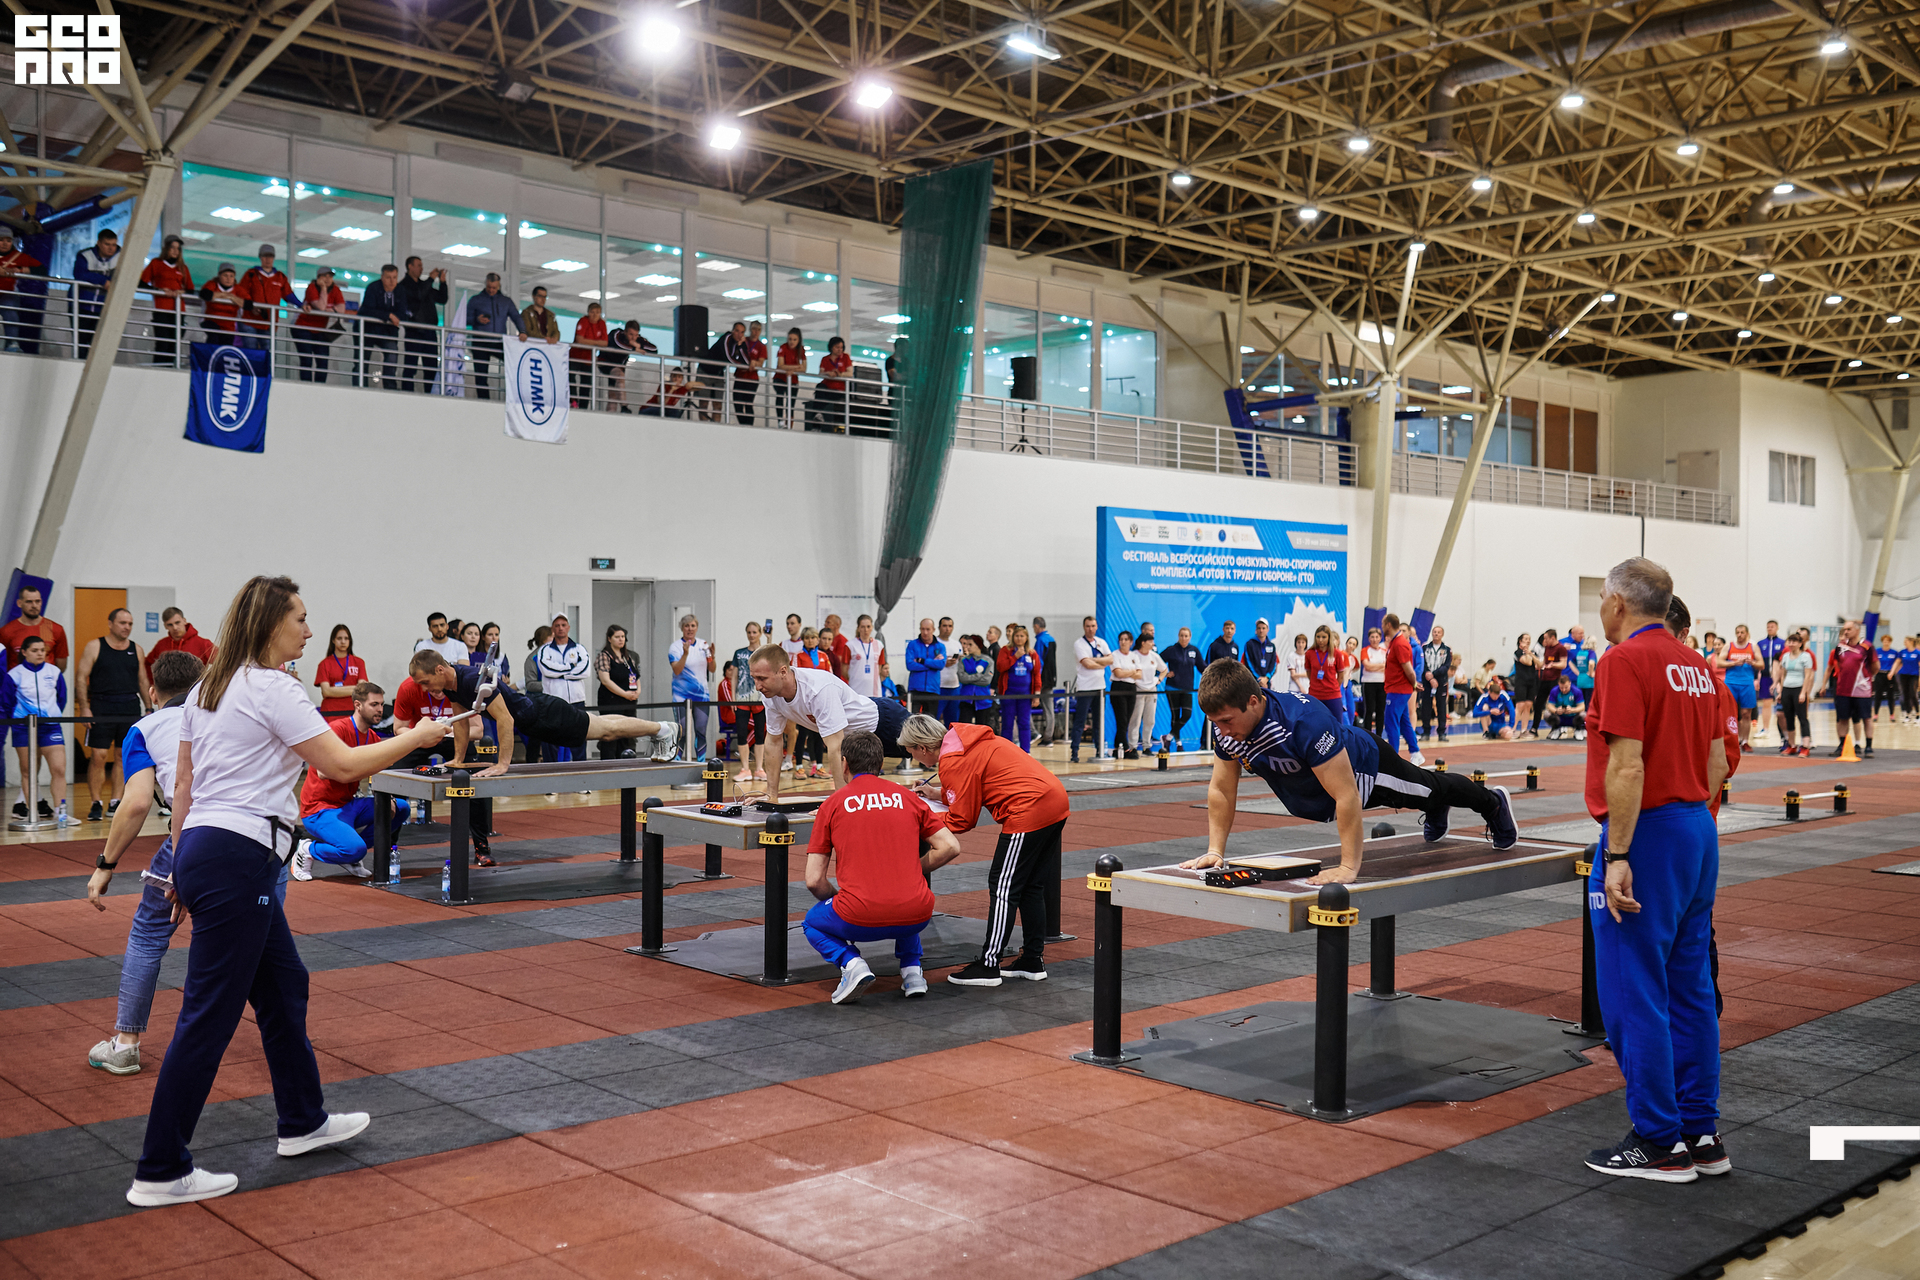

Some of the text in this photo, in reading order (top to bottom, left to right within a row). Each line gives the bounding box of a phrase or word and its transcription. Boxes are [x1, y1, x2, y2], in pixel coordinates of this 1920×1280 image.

[220, 355, 242, 421] НЛМК
[530, 358, 545, 415] НЛМК
[1122, 550, 1337, 571] ФЕСТИВАЛЬ ВСЕРОССИЙСКОГО ФИЗКУЛЬТУРНО-СПОРТИВНОГО
[1151, 566, 1315, 585] КОМПЛЕКСА «ГОТОВ К ТРУДУ И ОБОРОНЕ» (ГТО)
[1666, 663, 1716, 698] СУДЬЯ
[844, 793, 904, 813] СУДЬЯ
[1623, 1147, 1648, 1166] N
